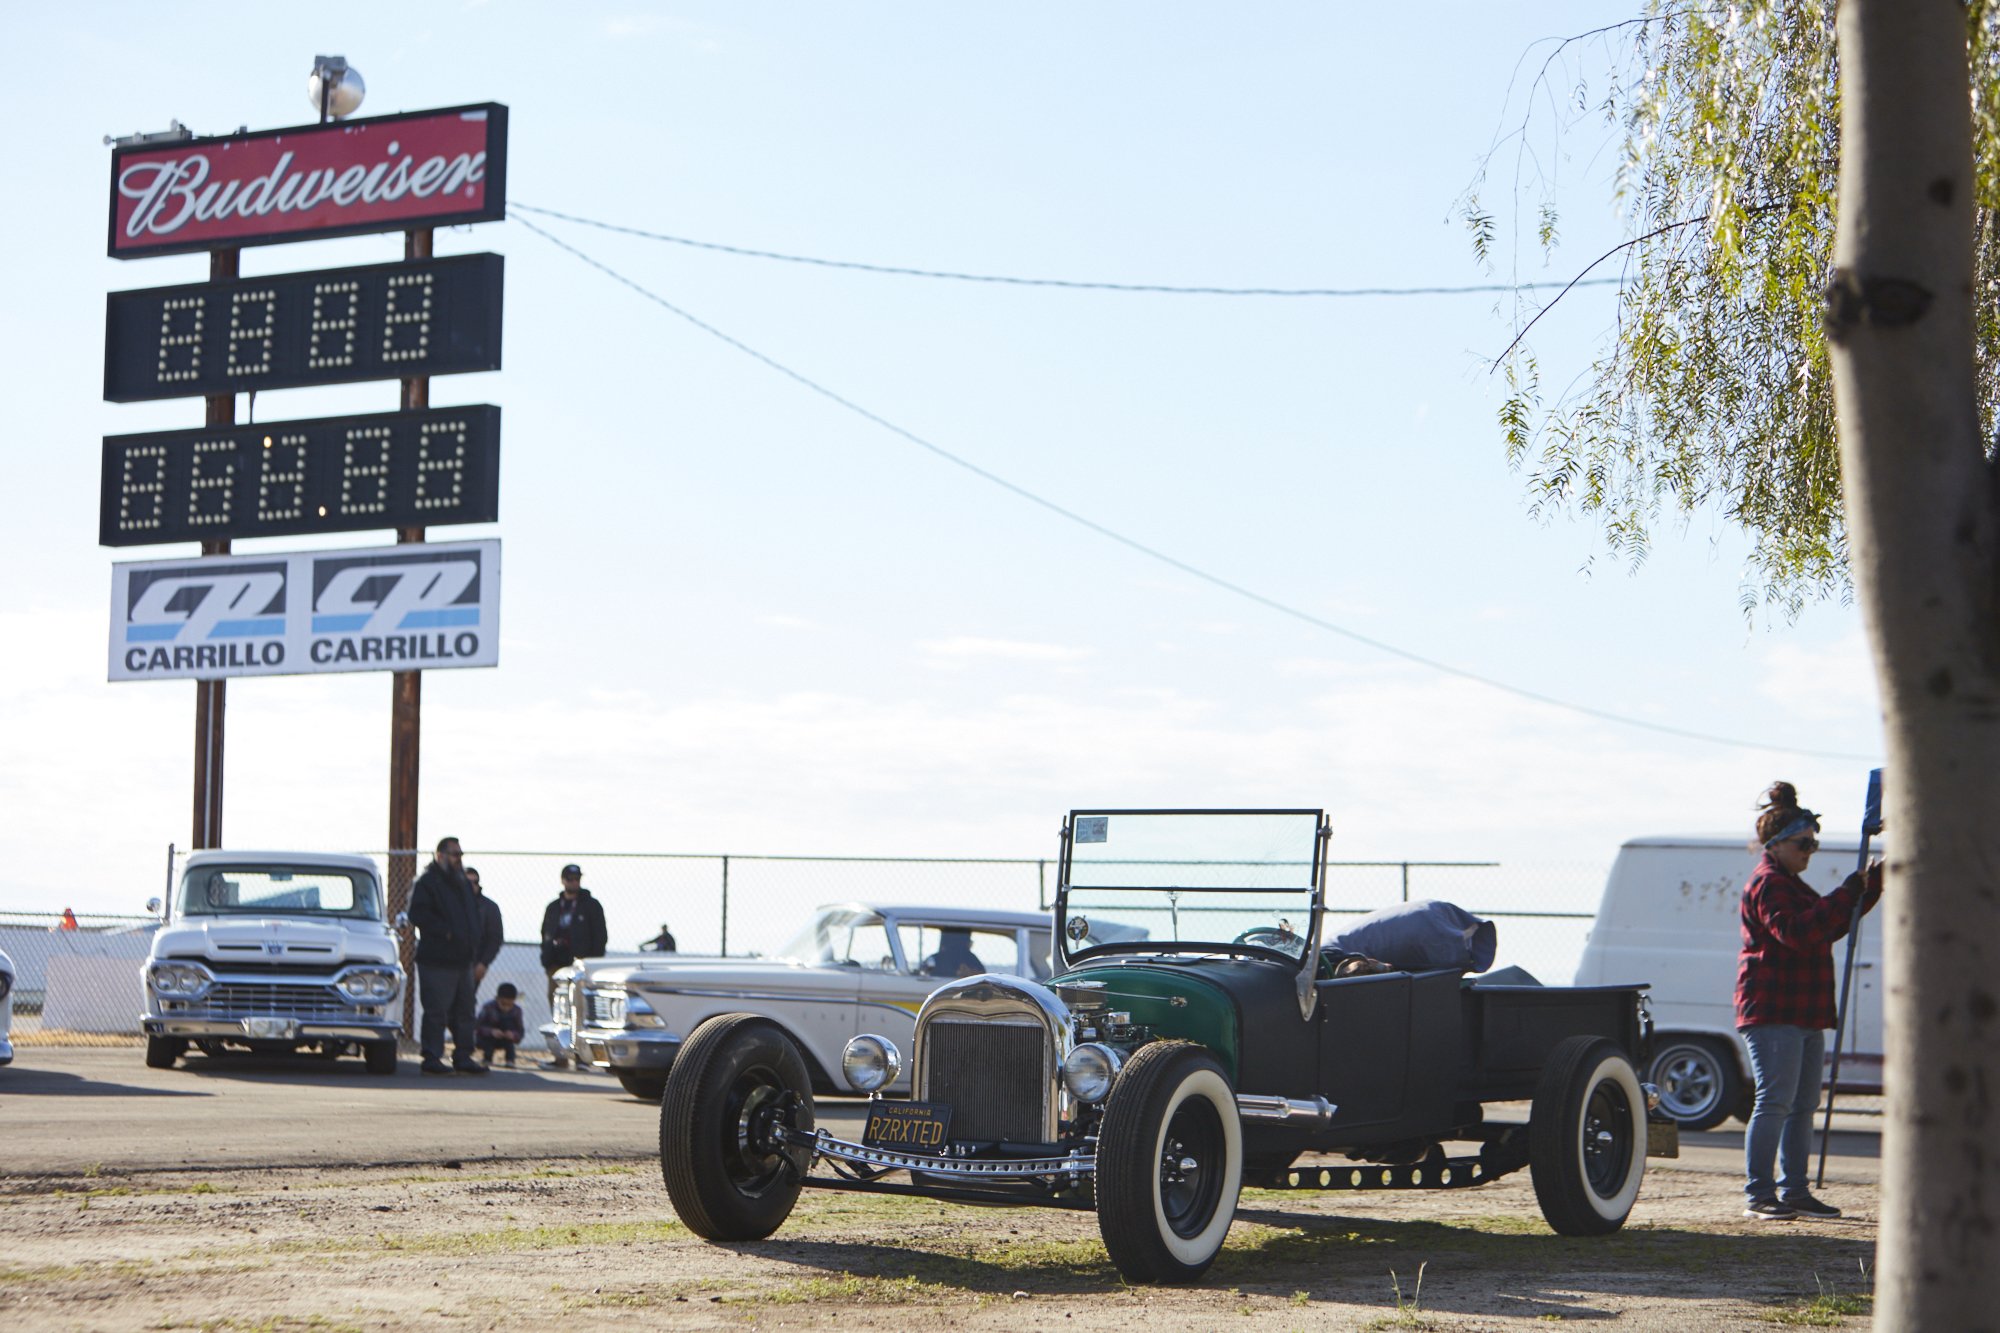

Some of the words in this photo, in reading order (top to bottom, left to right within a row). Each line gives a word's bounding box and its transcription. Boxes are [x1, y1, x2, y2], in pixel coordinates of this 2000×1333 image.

[118, 141, 486, 238] Budweiser
[124, 641, 286, 672] CARRILLO
[309, 631, 480, 664] CARRILLO
[888, 1106, 932, 1117] CALIFORNIA
[867, 1116, 943, 1145] RZRXTED
